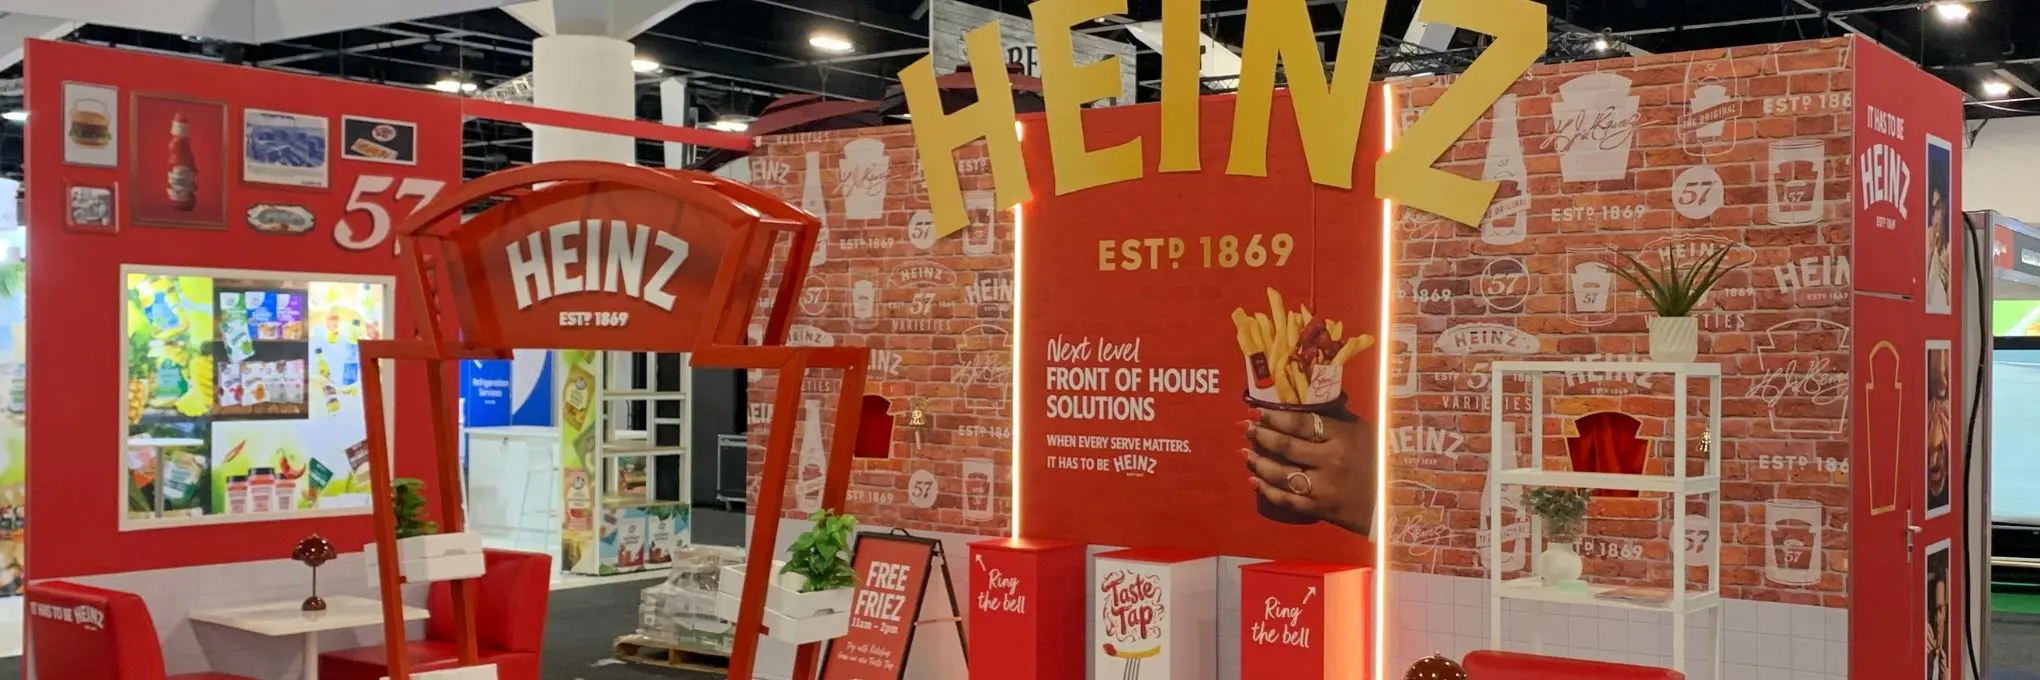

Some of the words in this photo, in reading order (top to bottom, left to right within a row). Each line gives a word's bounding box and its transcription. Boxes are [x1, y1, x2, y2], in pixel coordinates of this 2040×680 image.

[899, 0, 1548, 239] HEINZ
[1867, 104, 1874, 129] IT
[1874, 107, 1887, 135] HAS
[1887, 112, 1896, 138] TO
[1896, 116, 1904, 140] BE
[1677, 180, 1717, 206] 57
[1860, 143, 1910, 220] HEINZ
[1786, 191, 1805, 203] 57
[1601, 204, 1646, 220] 1869
[911, 221, 933, 240] 57
[1199, 233, 1294, 268] 1869
[506, 219, 689, 312] HEINZ
[901, 266, 944, 281] HEINZ
[803, 287, 823, 304] 57
[1487, 275, 1519, 296] 57
[910, 293, 936, 316] 57
[1582, 293, 1600, 304] 57
[595, 312, 630, 327] 1869
[892, 319, 952, 332] VARIETIES
[1047, 334, 1092, 363] Next
[1098, 337, 1140, 362] level
[1454, 331, 1518, 348] HEINZ
[1046, 367, 1110, 391] FRONT
[1114, 367, 1142, 392] OF
[1149, 368, 1221, 394] HOUSE
[1467, 362, 1491, 389] 5
[1046, 395, 1156, 421] SOLUTIONS
[1442, 396, 1533, 411] VARIEIES
[1046, 434, 1076, 448] WHEN
[1078, 435, 1109, 449] EVERY
[1110, 436, 1141, 450] SERVE
[1143, 438, 1191, 453] MATTERS.
[1047, 456, 1056, 469] IT
[1058, 456, 1078, 470] HAS
[1080, 457, 1094, 471] TO
[1097, 458, 1109, 471] BE
[1113, 454, 1157, 474] HEINZ
[868, 491, 894, 504] 1869
[911, 480, 934, 499] 57
[1600, 541, 1644, 559] 1869
[1784, 550, 1802, 563] 57
[865, 560, 911, 592] FREE
[987, 568, 1020, 594] Ring
[1102, 571, 1158, 608] Taste
[854, 589, 906, 622] FRIEZ
[977, 591, 1001, 612] the
[1002, 593, 1026, 614] bell
[1264, 596, 1303, 627] Ring
[73, 604, 104, 629] HEINZ
[851, 617, 872, 630] 11am
[1111, 604, 1153, 639] Tap
[1251, 621, 1279, 645] the
[1282, 623, 1310, 648] bell
